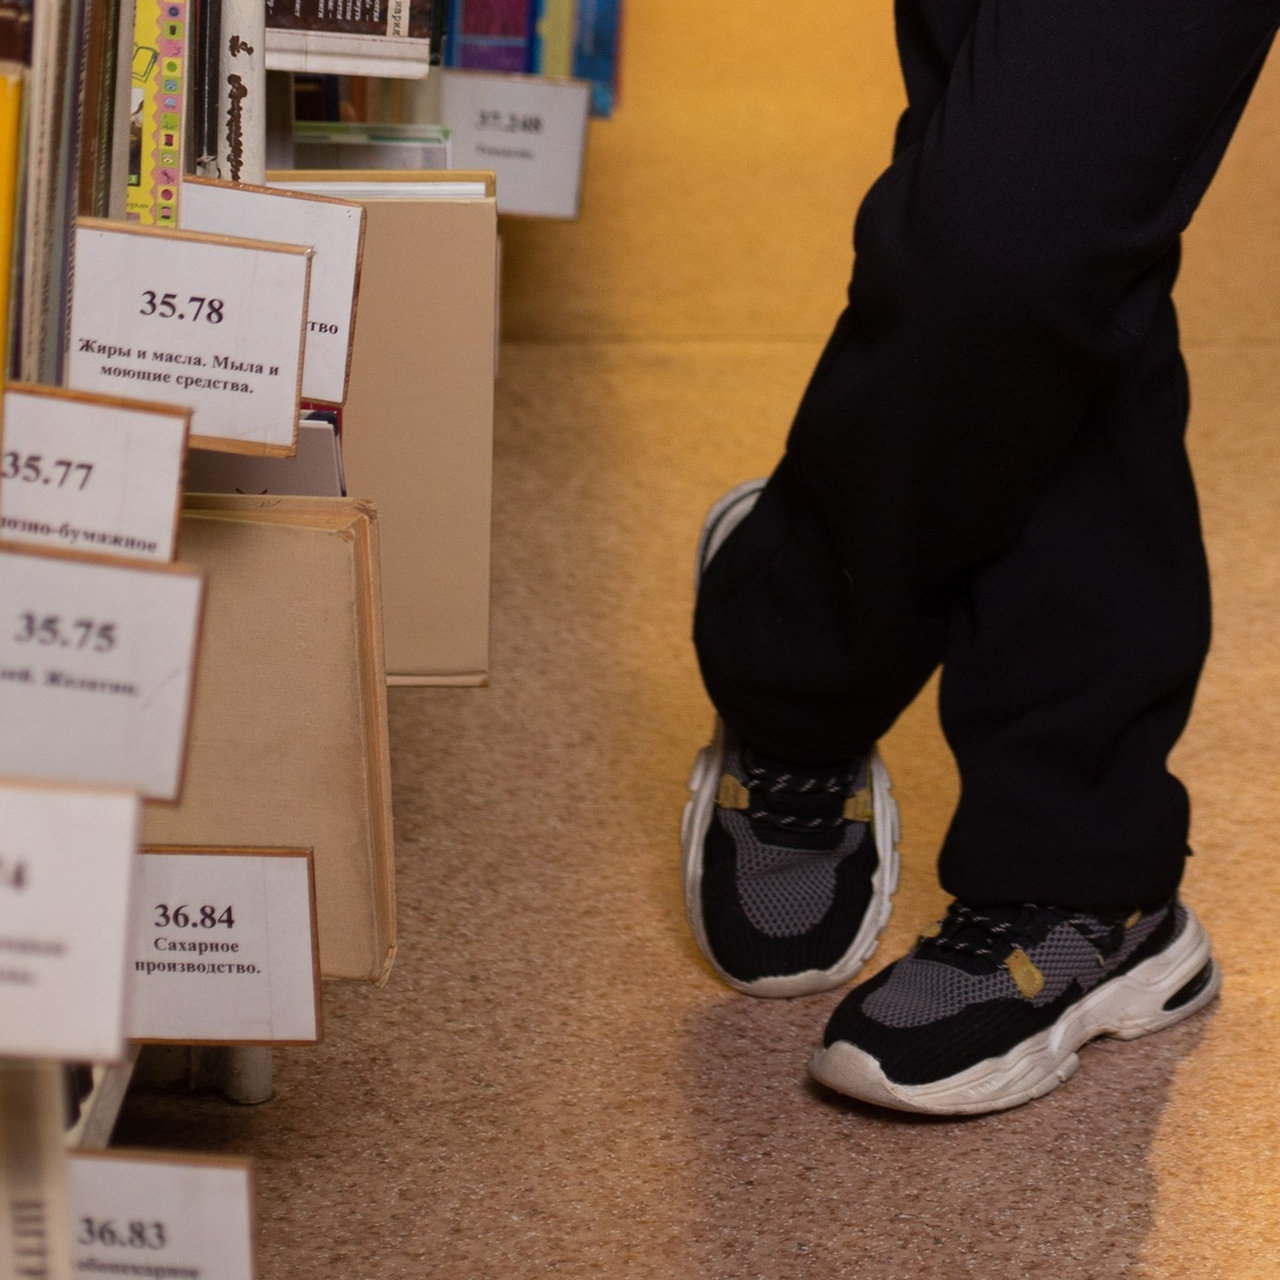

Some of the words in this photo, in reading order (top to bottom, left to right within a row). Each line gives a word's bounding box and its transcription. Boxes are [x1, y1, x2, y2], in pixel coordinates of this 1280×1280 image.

[139, 290, 224, 324] 35.78
[307, 320, 339, 335] тво
[78, 337, 132, 359] Жиры
[136, 350, 147, 360] и
[152, 344, 207, 368] масла.
[212, 355, 263, 375] Мыла
[269, 366, 280, 377] и
[99, 363, 171, 383] моющие
[175, 374, 254, 394] средства.
[2, 451, 94, 491] 35.77
[14, 611, 117, 653] 35.75
[153, 904, 236, 929] 36.84
[153, 937, 240, 955] Сахарное
[135, 960, 262, 975] производство.
[78, 1216, 167, 1250] 36.83
